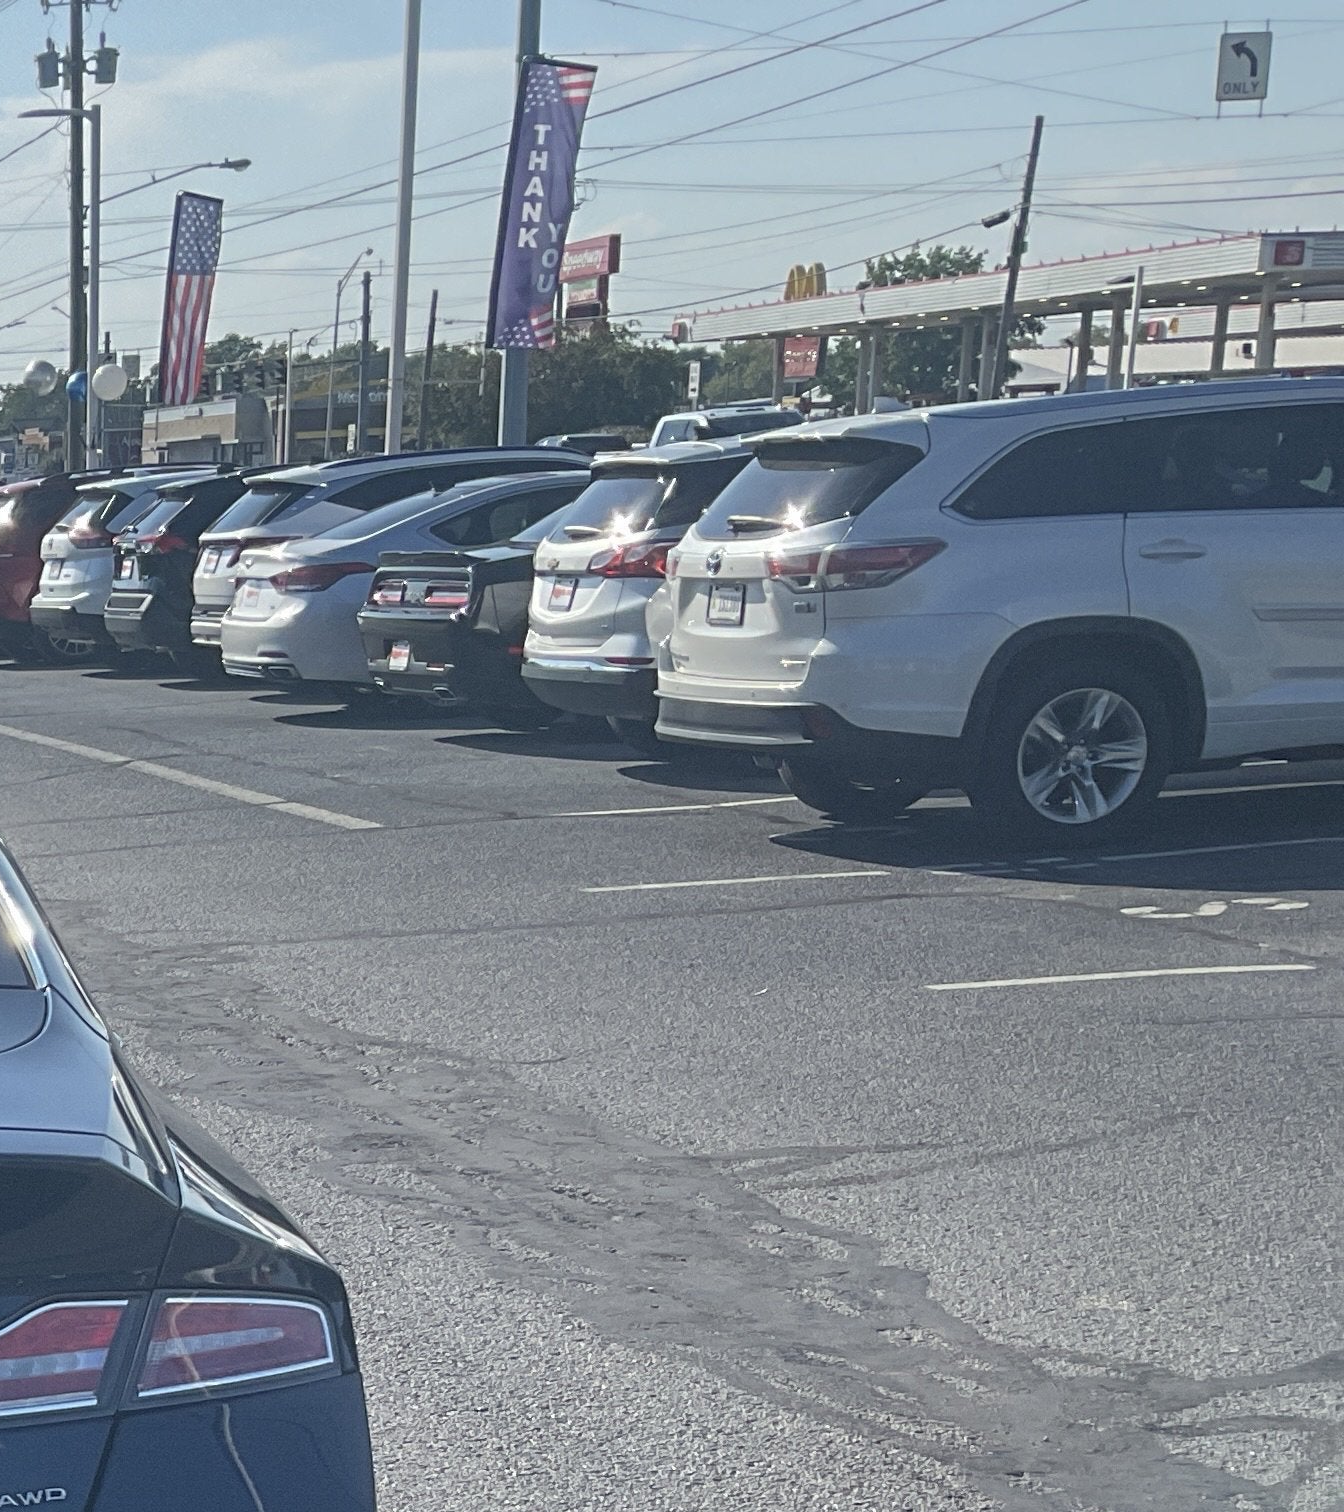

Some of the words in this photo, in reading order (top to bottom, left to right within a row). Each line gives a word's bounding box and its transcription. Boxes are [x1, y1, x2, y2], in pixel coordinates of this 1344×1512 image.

[1223, 80, 1260, 95] ONLY
[517, 123, 552, 249] THANK
[535, 221, 564, 294] YOU
